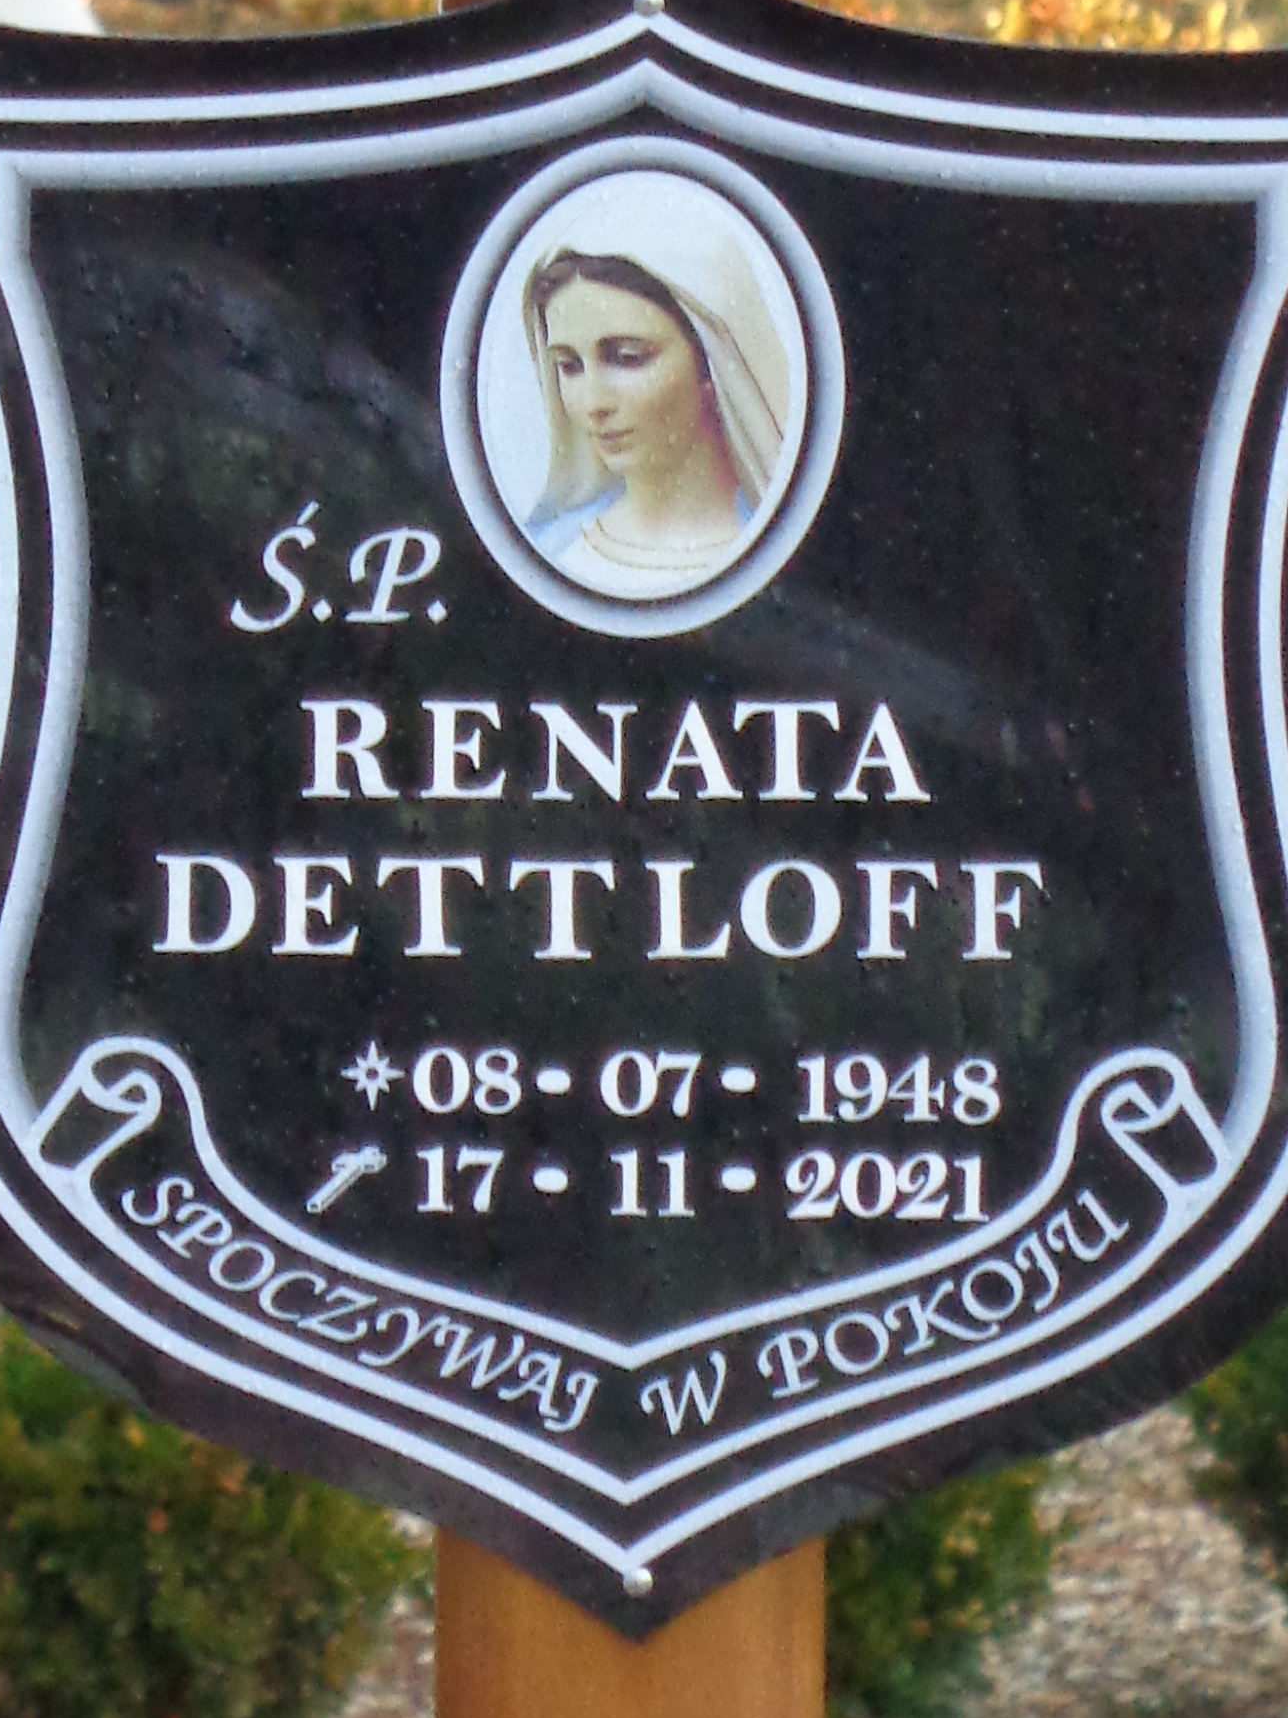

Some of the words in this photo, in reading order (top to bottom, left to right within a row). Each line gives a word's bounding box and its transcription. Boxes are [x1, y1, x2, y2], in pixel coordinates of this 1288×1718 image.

[299, 698, 932, 803] RENATA
[151, 853, 1044, 961] DETTLOFF
[120, 1176, 600, 1433] SPOCZYWAJ
[639, 1349, 728, 1436] W
[756, 1188, 1130, 1399] POKOJU
